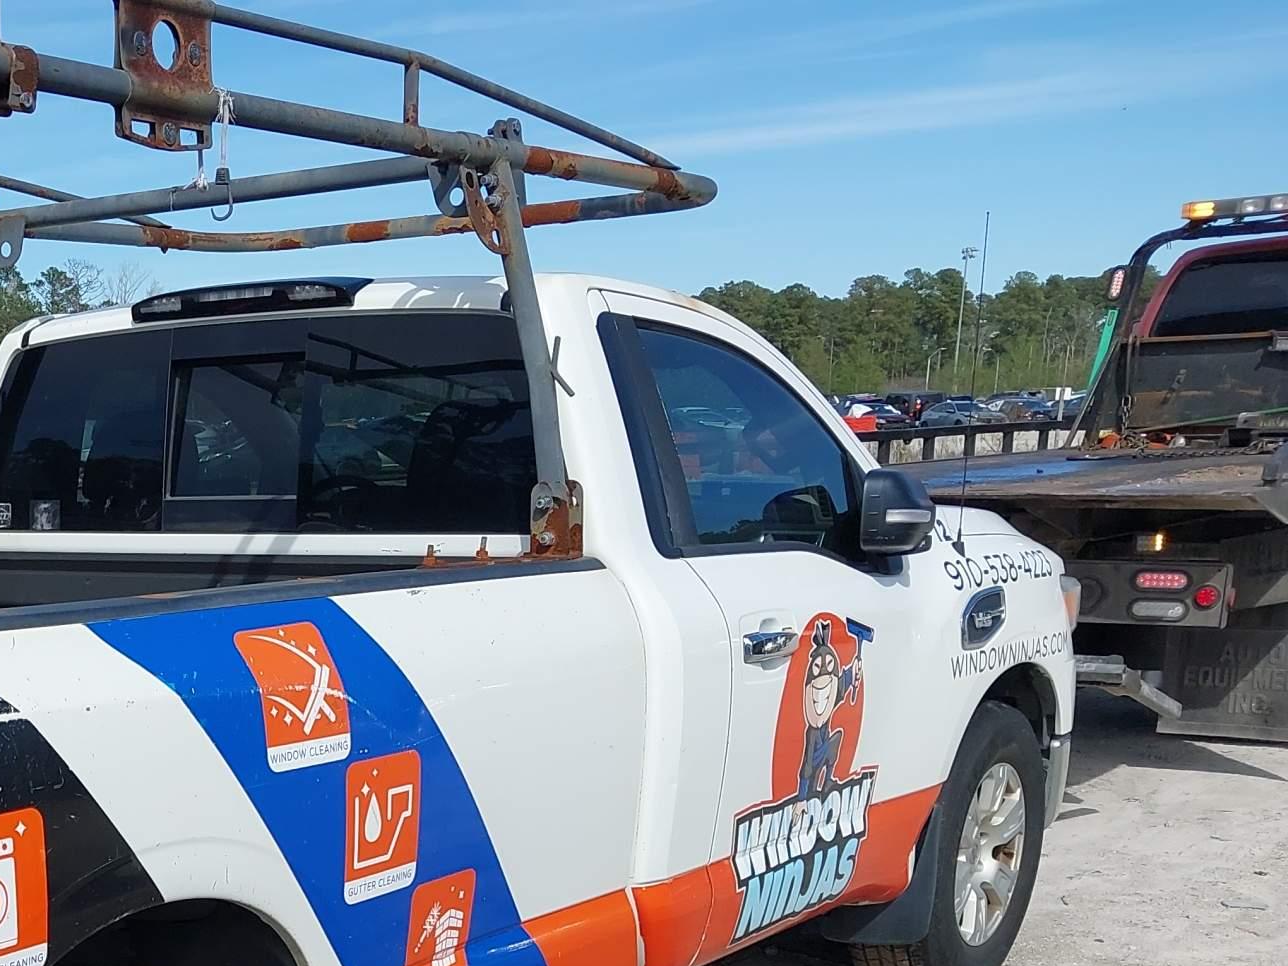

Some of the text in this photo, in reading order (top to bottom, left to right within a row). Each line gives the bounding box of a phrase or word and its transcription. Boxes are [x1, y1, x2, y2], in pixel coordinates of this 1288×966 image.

[944, 550, 1052, 591] 910-538-4223
[1184, 665, 1288, 691] EQUIPME
[270, 740, 349, 764] WINDOW CLEANING
[735, 778, 873, 880] WINDOW
[348, 869, 413, 897] GUTTER CLEANING
[735, 838, 859, 939] NINJAS
